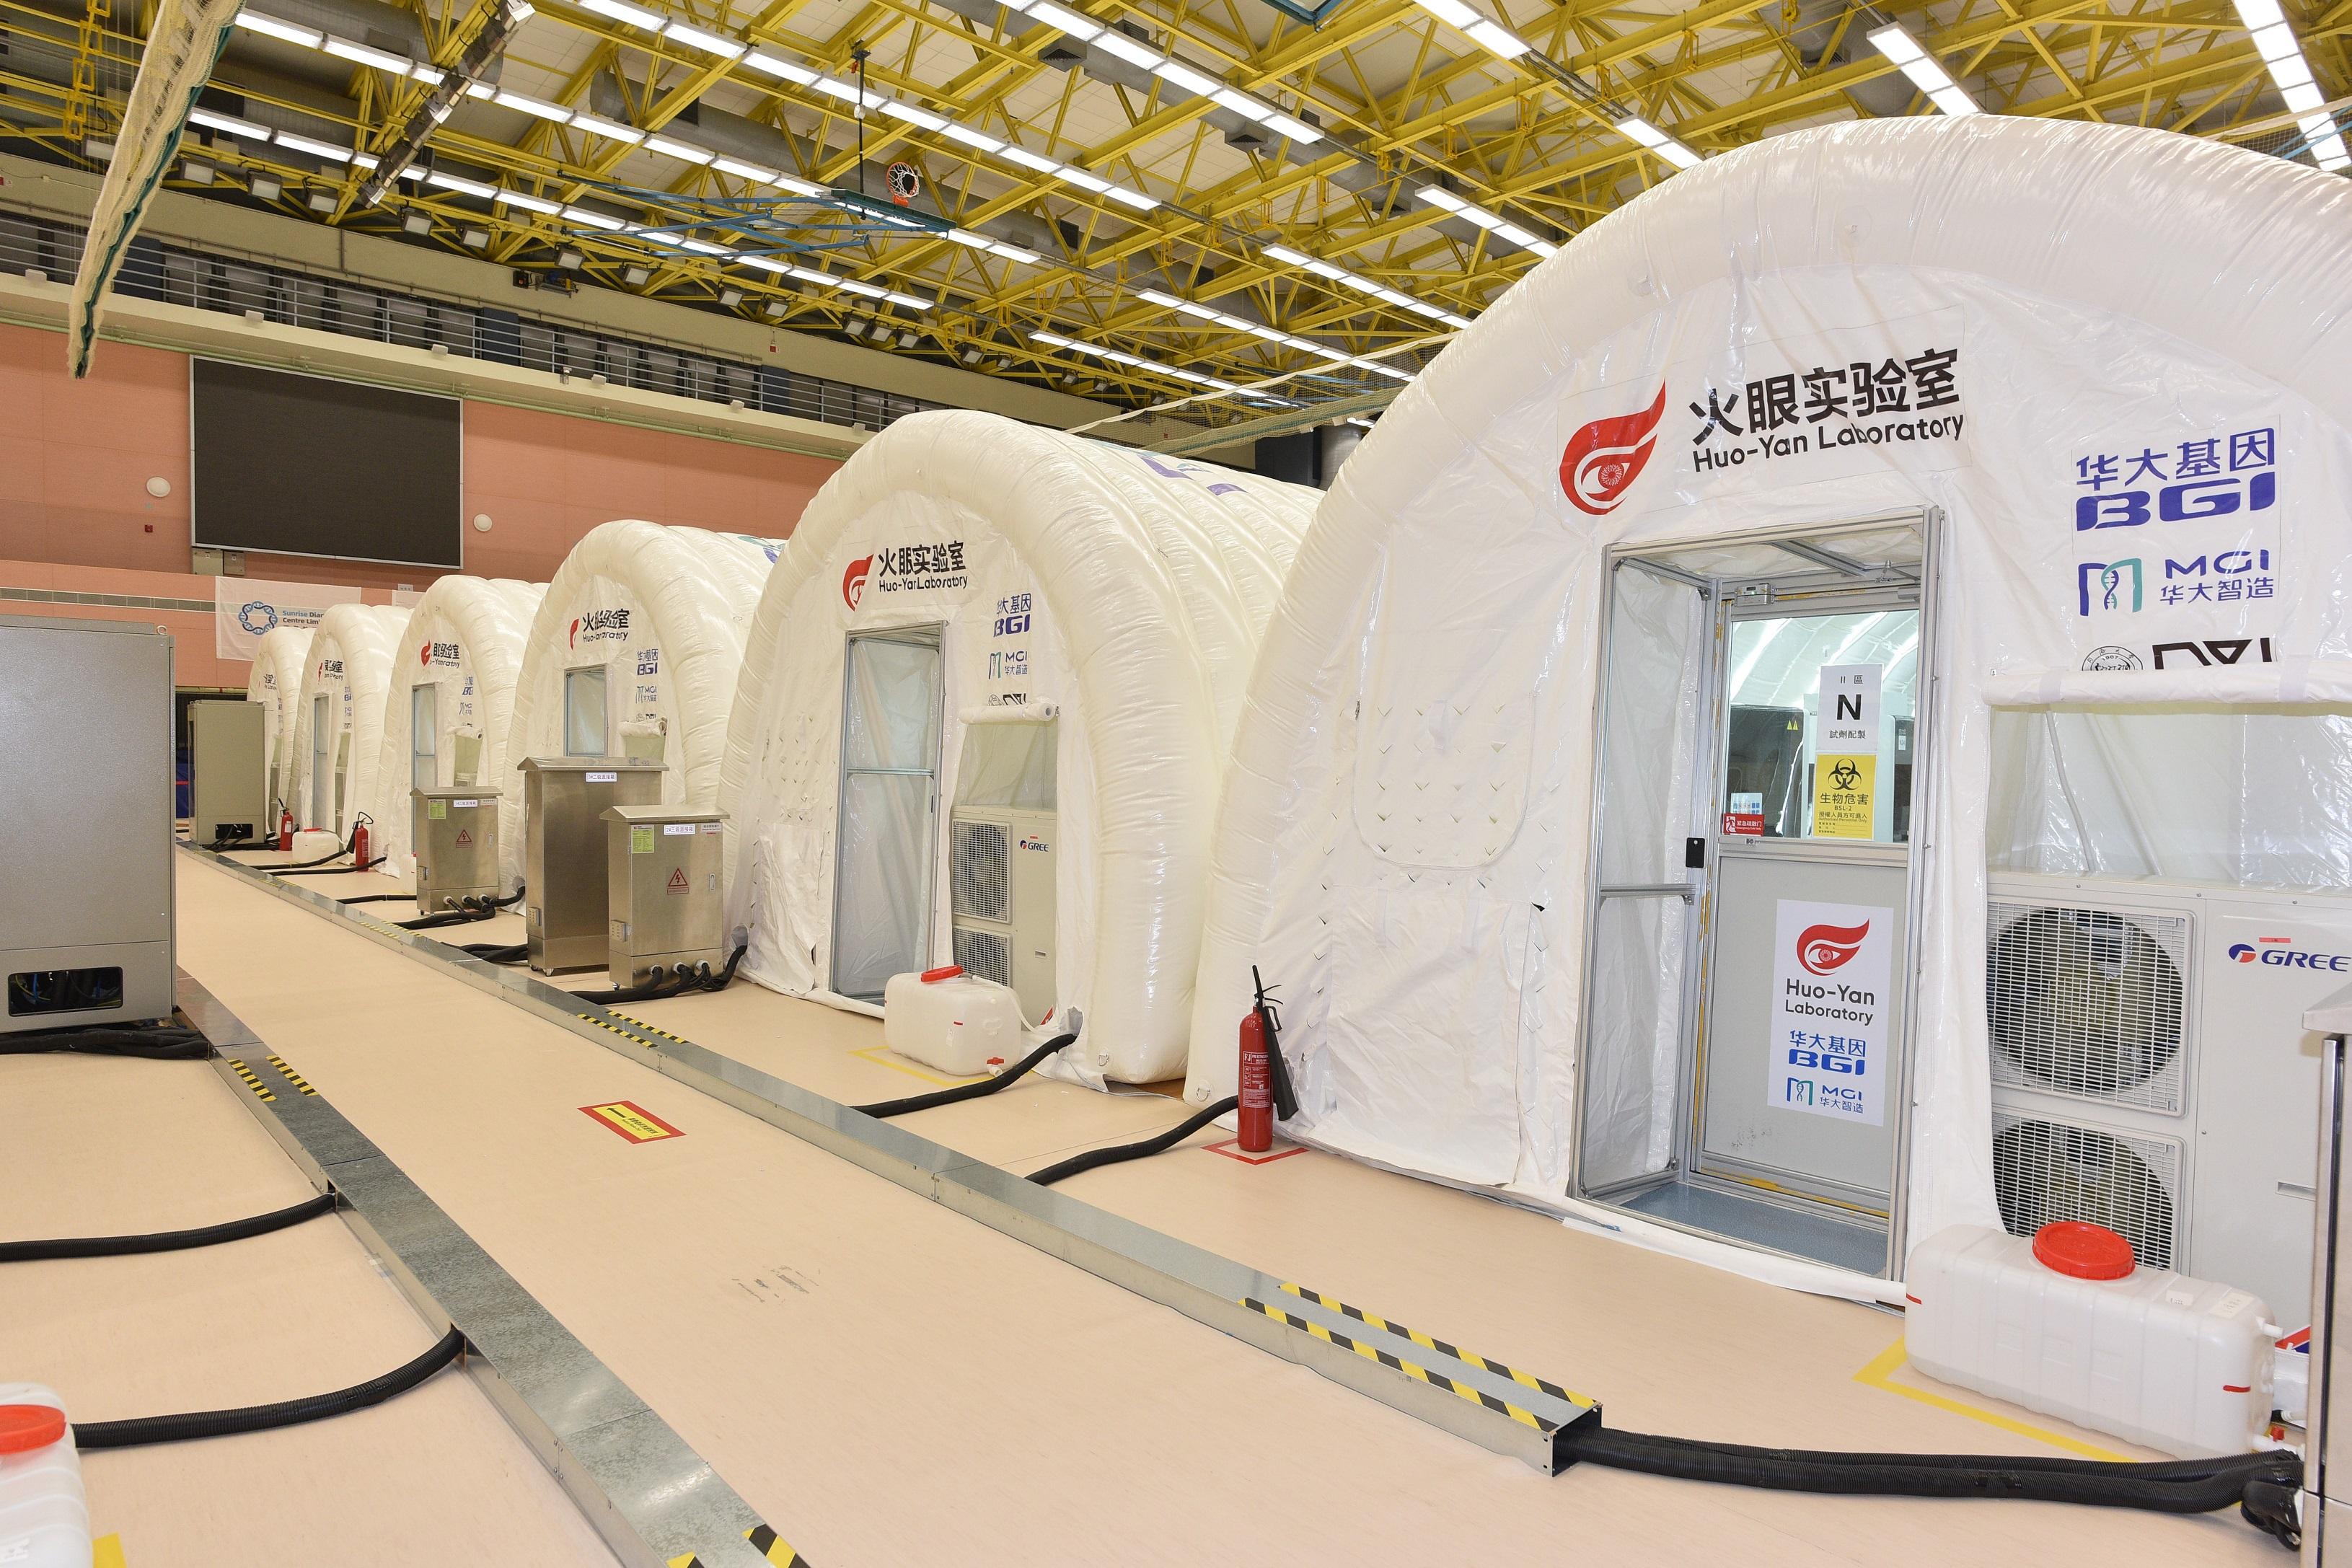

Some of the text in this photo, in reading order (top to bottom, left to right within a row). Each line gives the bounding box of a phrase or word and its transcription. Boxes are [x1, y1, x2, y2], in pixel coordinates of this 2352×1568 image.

[1688, 348, 1960, 446] 火眼实验室
[1693, 413, 1965, 472] Huo-Yan Laboratory
[2076, 428, 2275, 491] 华大基因
[2076, 471, 2276, 532] BGI
[878, 539, 966, 577] 火眼实验室
[2164, 549, 2269, 579] MGI
[916, 576, 968, 590] Laboratory
[2159, 577, 2273, 606] 华大智造
[993, 614, 1031, 638] BGI
[637, 662, 658, 676] BGI
[1004, 663, 1028, 676] 华大智造
[1005, 651, 1028, 663] MGI
[1854, 674, 1863, 684] 區
[1836, 694, 1862, 721] N
[1829, 729, 1866, 739] 試劑配製
[1820, 793, 1869, 805] 生物危害
[1028, 842, 1049, 853] GREE
[2261, 949, 2351, 972] GREE
[1786, 978, 1875, 1005] Huo-Yan
[1785, 1000, 1873, 1026] Laboratory
[1789, 1030, 1866, 1057] 华大基因
[1788, 1049, 1866, 1075] BGI
[1819, 1096, 1864, 1114] 华大智造
[1822, 1084, 1862, 1101] MGI
